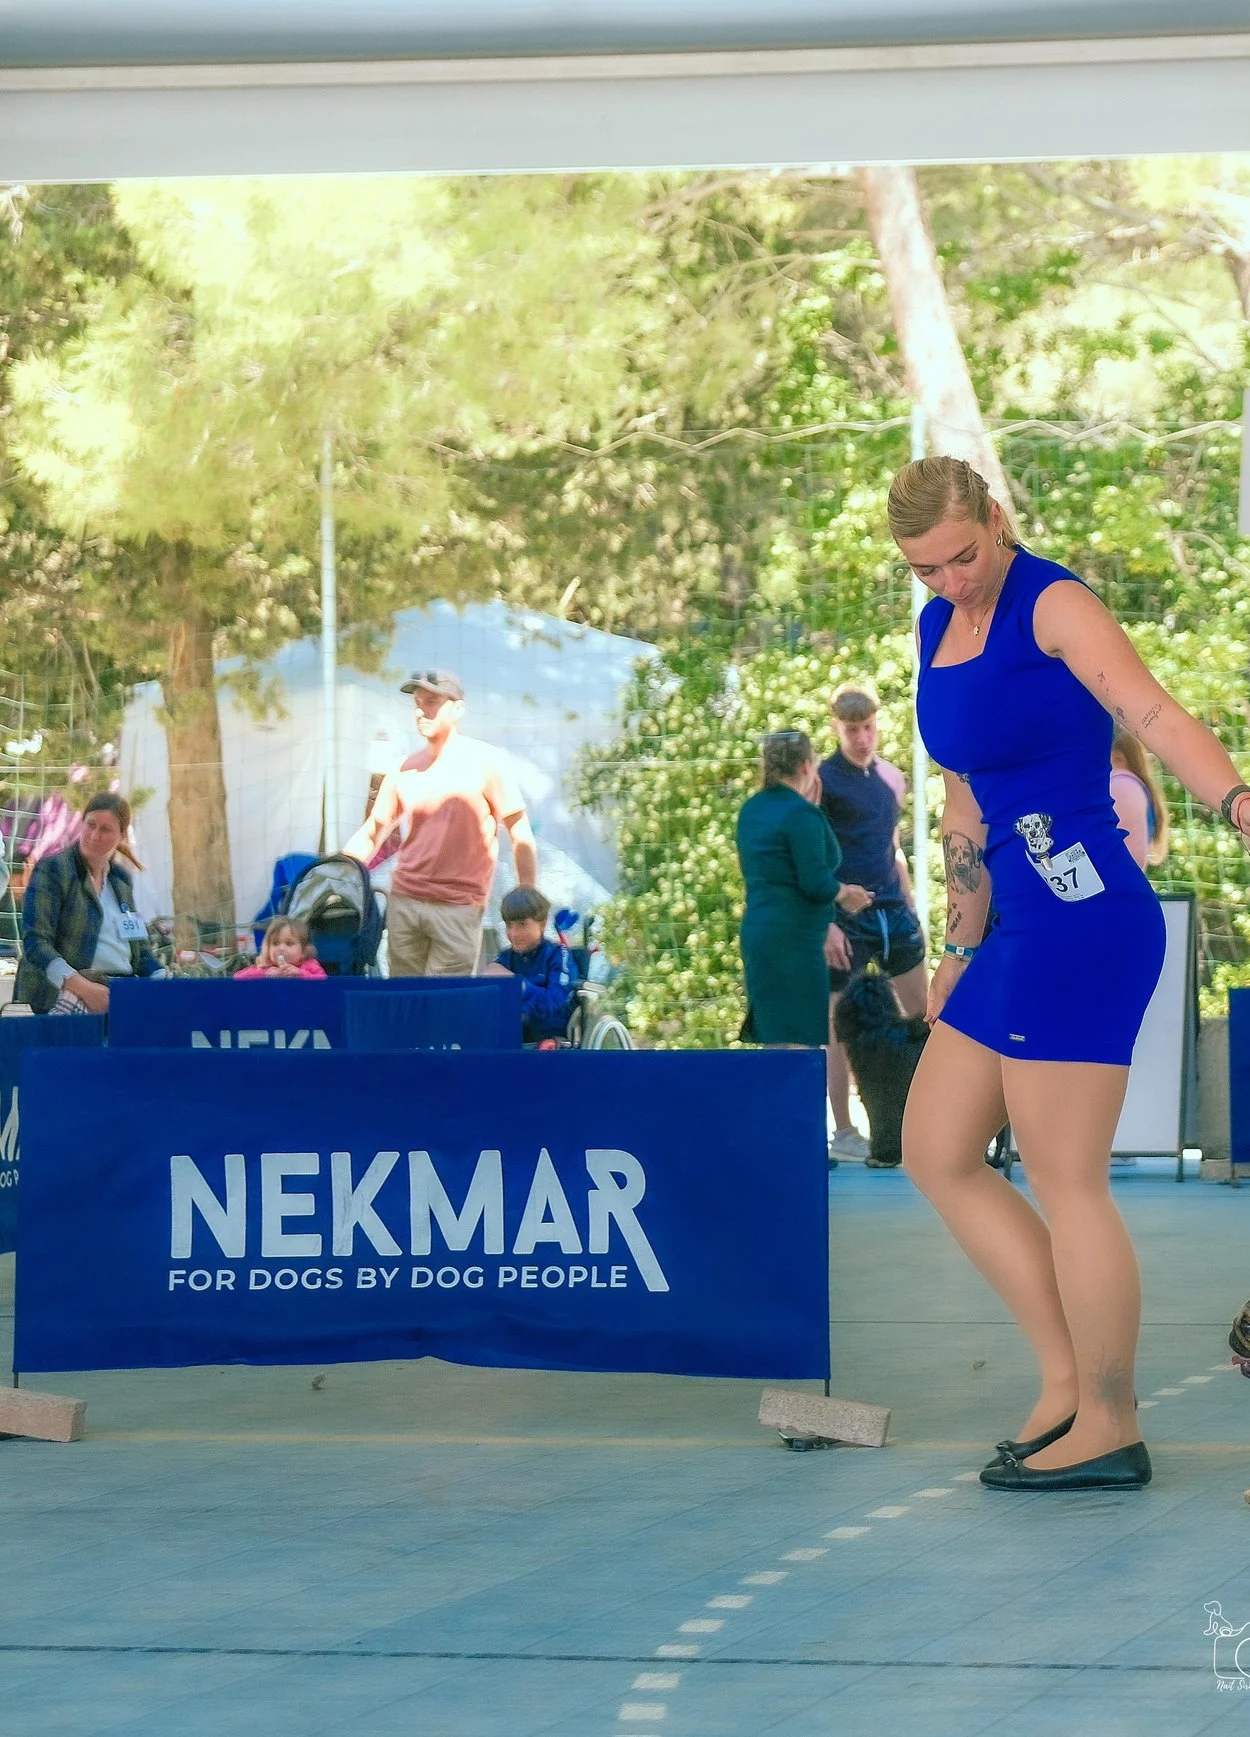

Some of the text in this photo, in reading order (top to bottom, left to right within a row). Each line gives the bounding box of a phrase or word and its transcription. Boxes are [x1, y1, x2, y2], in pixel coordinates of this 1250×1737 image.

[1044, 866, 1079, 893] 37
[168, 1147, 670, 1292] NEKMAR
[168, 1265, 628, 1291] FOR DOGS BY DOG PEOPLE
